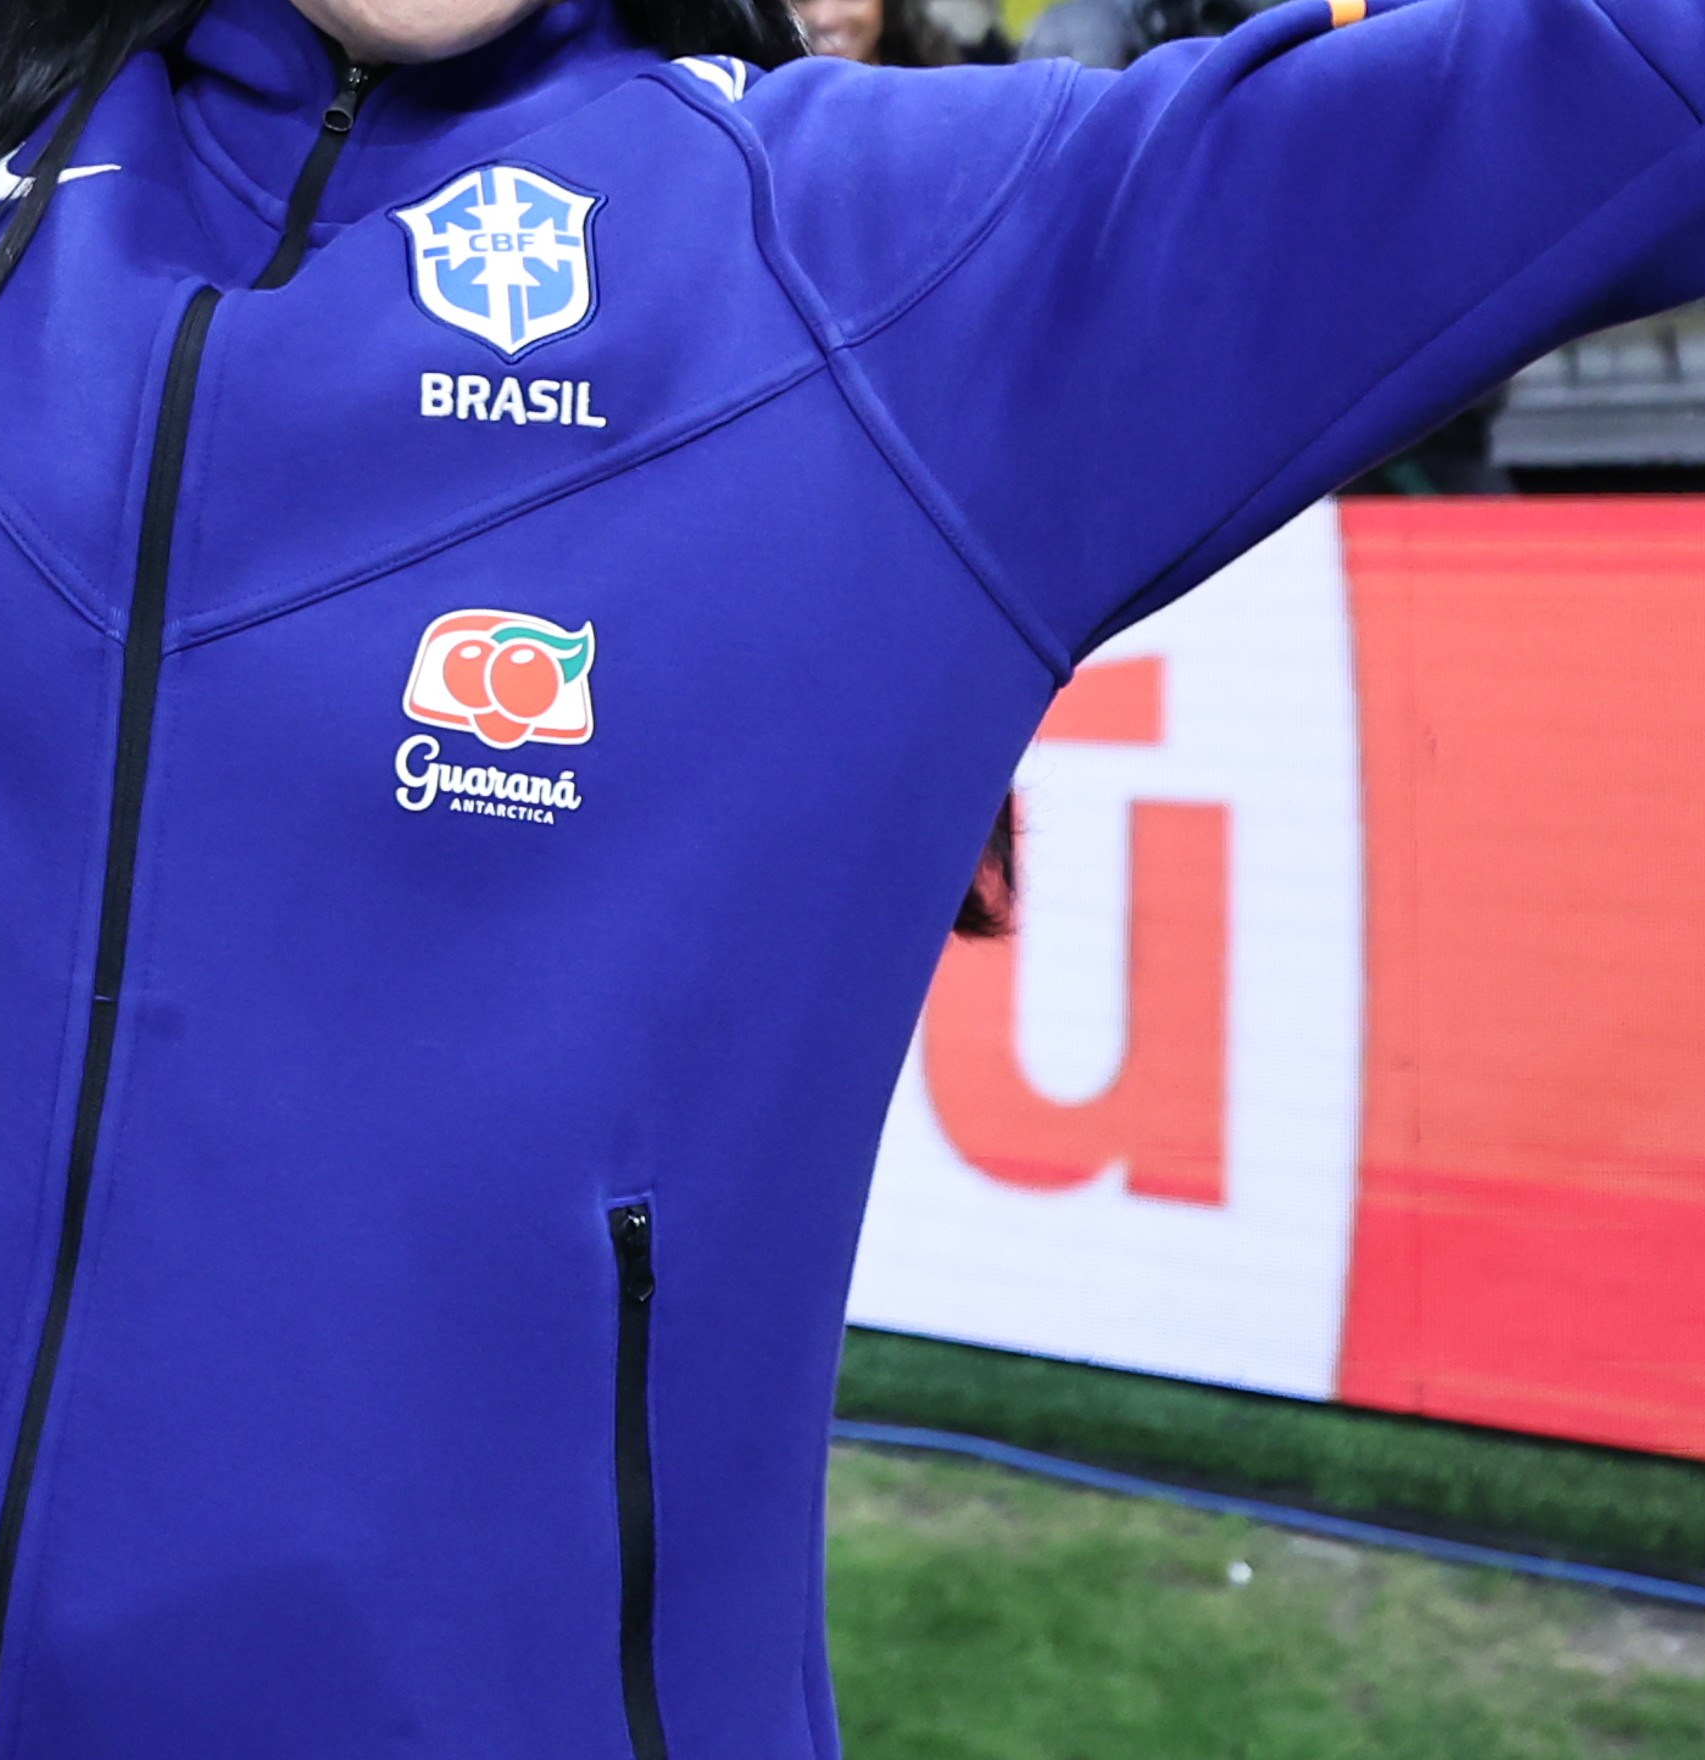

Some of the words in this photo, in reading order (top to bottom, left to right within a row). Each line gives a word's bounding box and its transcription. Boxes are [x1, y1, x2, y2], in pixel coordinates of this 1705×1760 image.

[468, 232, 536, 252] CBF
[420, 371, 608, 429] BRASIL
[395, 733, 582, 812] Guaraná
[449, 796, 555, 825] ANTARCTICA
